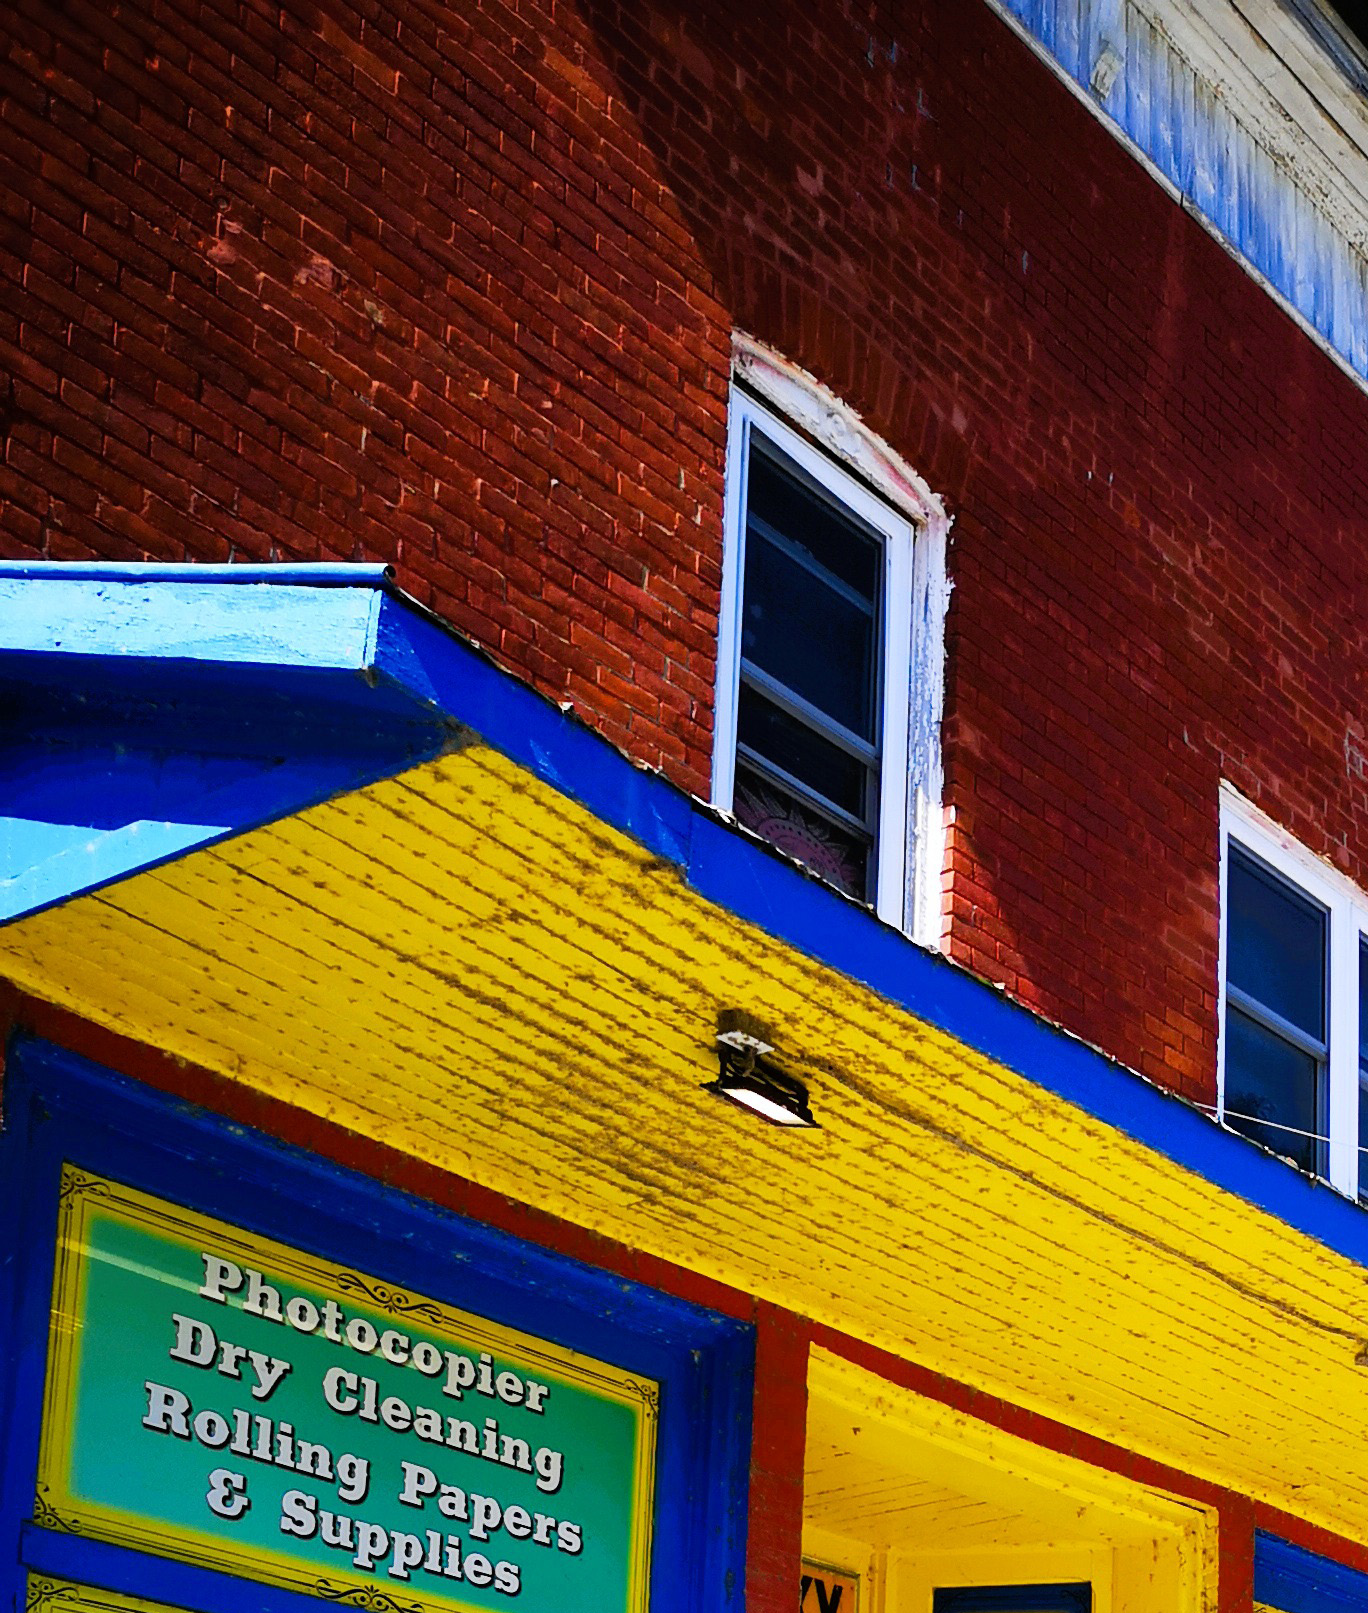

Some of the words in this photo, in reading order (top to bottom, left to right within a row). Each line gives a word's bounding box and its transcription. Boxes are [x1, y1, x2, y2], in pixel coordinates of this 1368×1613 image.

[170, 1313, 291, 1399] Dry
[322, 1367, 564, 1491] Cleaning
[200, 1253, 548, 1414] Photocopier
[141, 1381, 369, 1502] Rolling
[400, 1462, 584, 1555] Papers
[206, 1469, 251, 1520] &
[280, 1491, 521, 1596] Supplies
